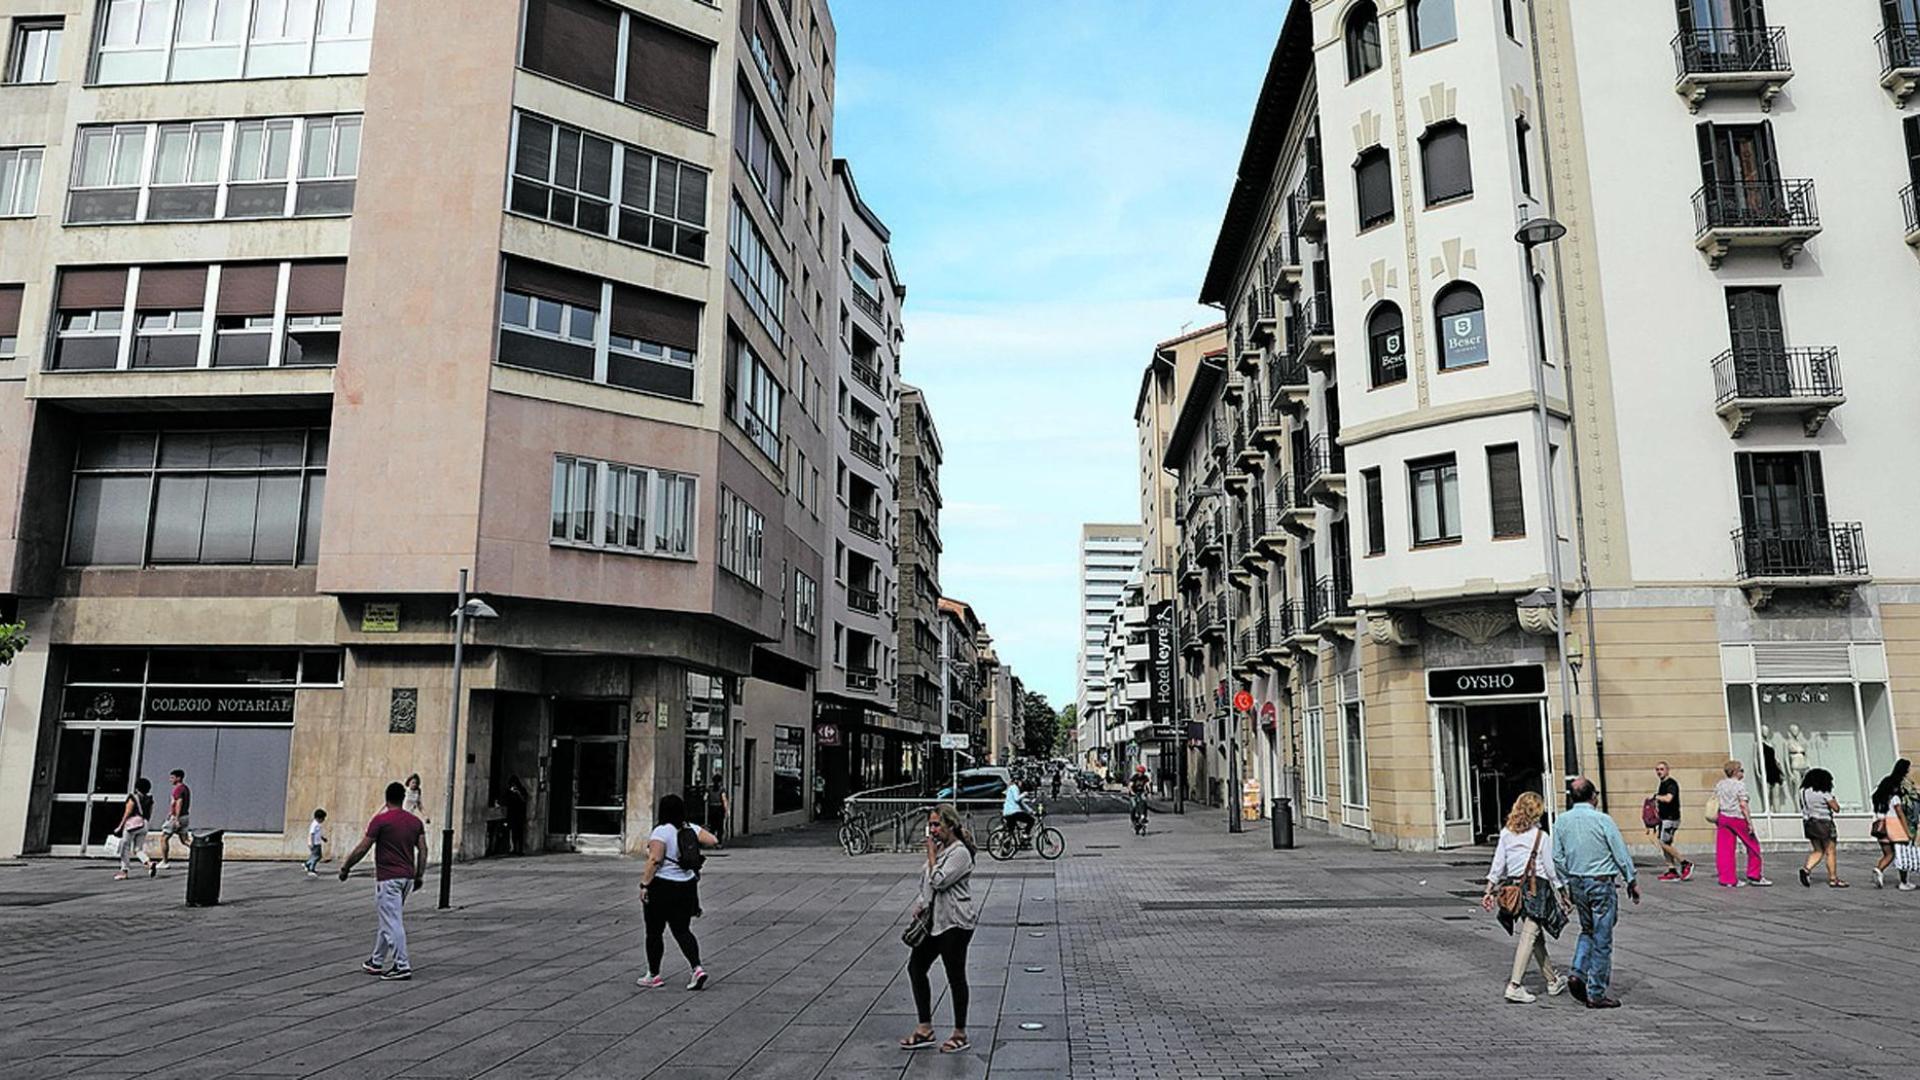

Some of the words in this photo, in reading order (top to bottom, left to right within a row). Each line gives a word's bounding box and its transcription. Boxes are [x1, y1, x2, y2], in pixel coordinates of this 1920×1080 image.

[1157, 666, 1170, 703] Hotel
[1457, 673, 1514, 690] OYSHO
[151, 698, 212, 712] COLEGIO
[217, 698, 292, 712] NOTARIAL
[634, 711, 649, 723] 27
